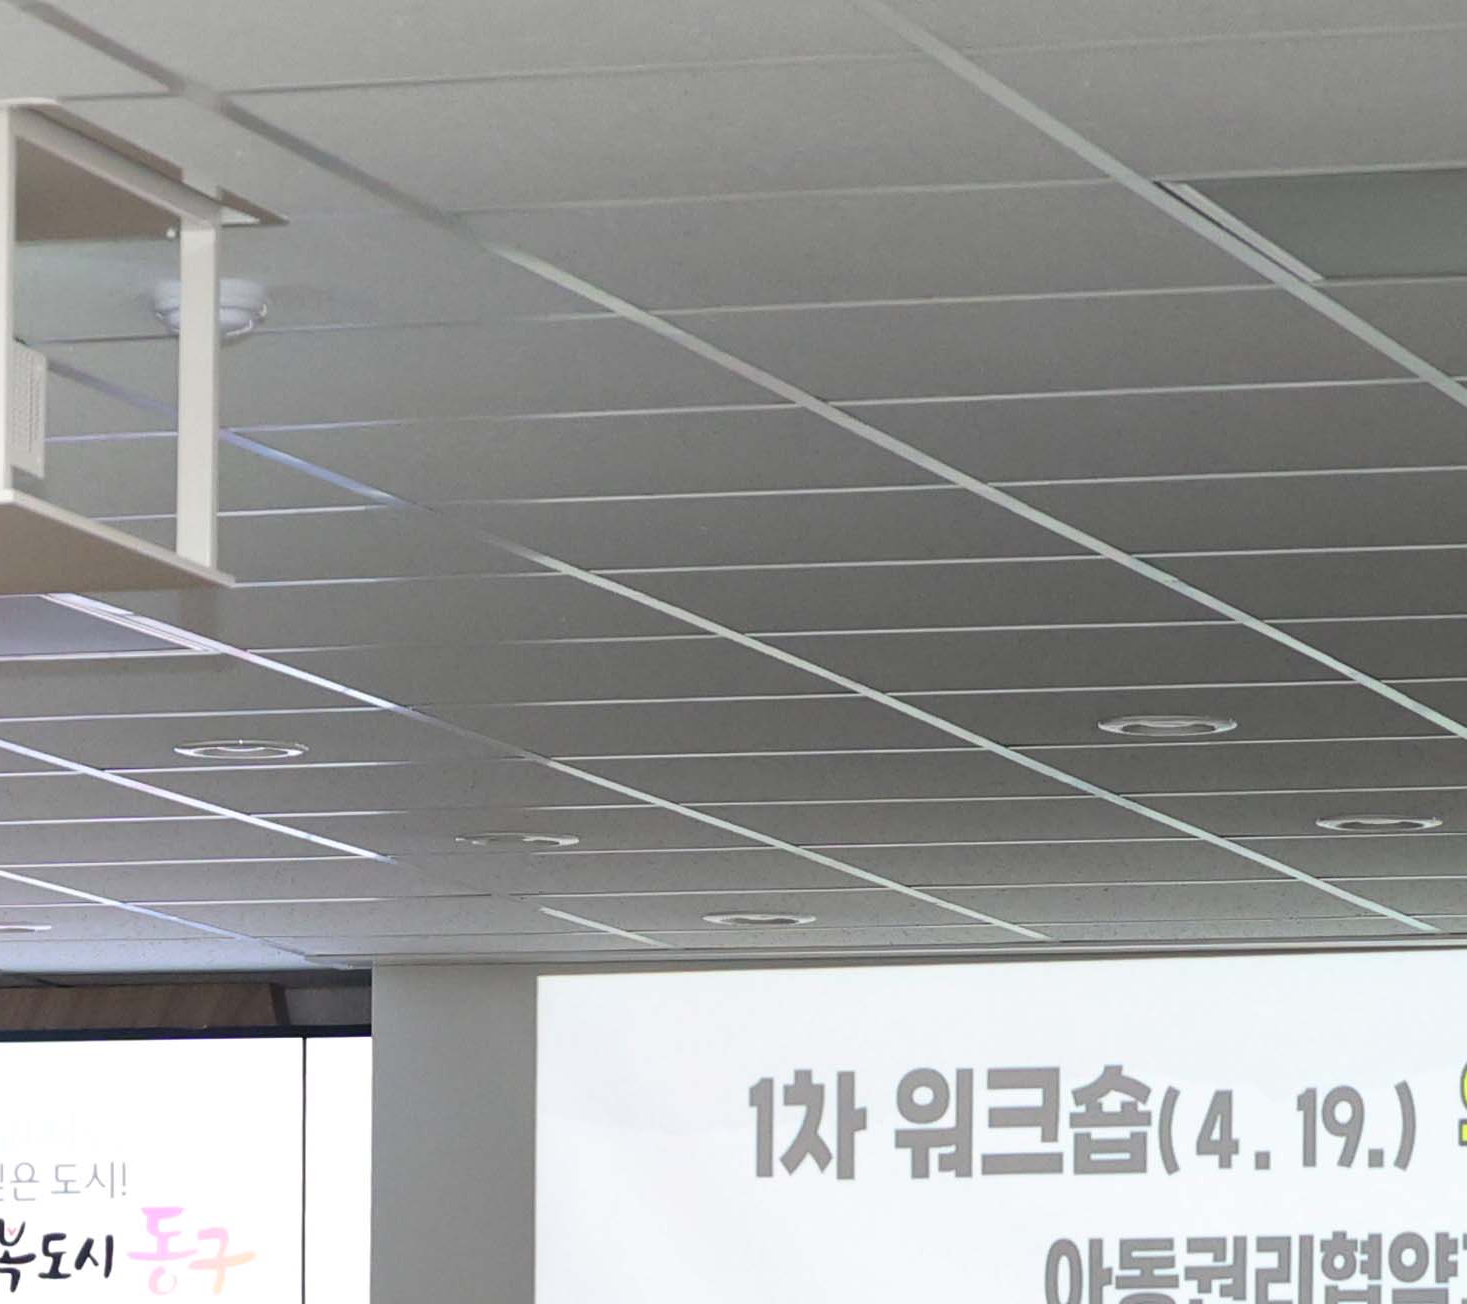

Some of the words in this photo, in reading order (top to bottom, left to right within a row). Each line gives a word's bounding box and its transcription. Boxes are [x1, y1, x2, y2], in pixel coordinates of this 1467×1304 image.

[748, 1069, 868, 1181] 1차
[50, 1161, 129, 1199] 도시!
[127, 1205, 257, 1295] 동구
